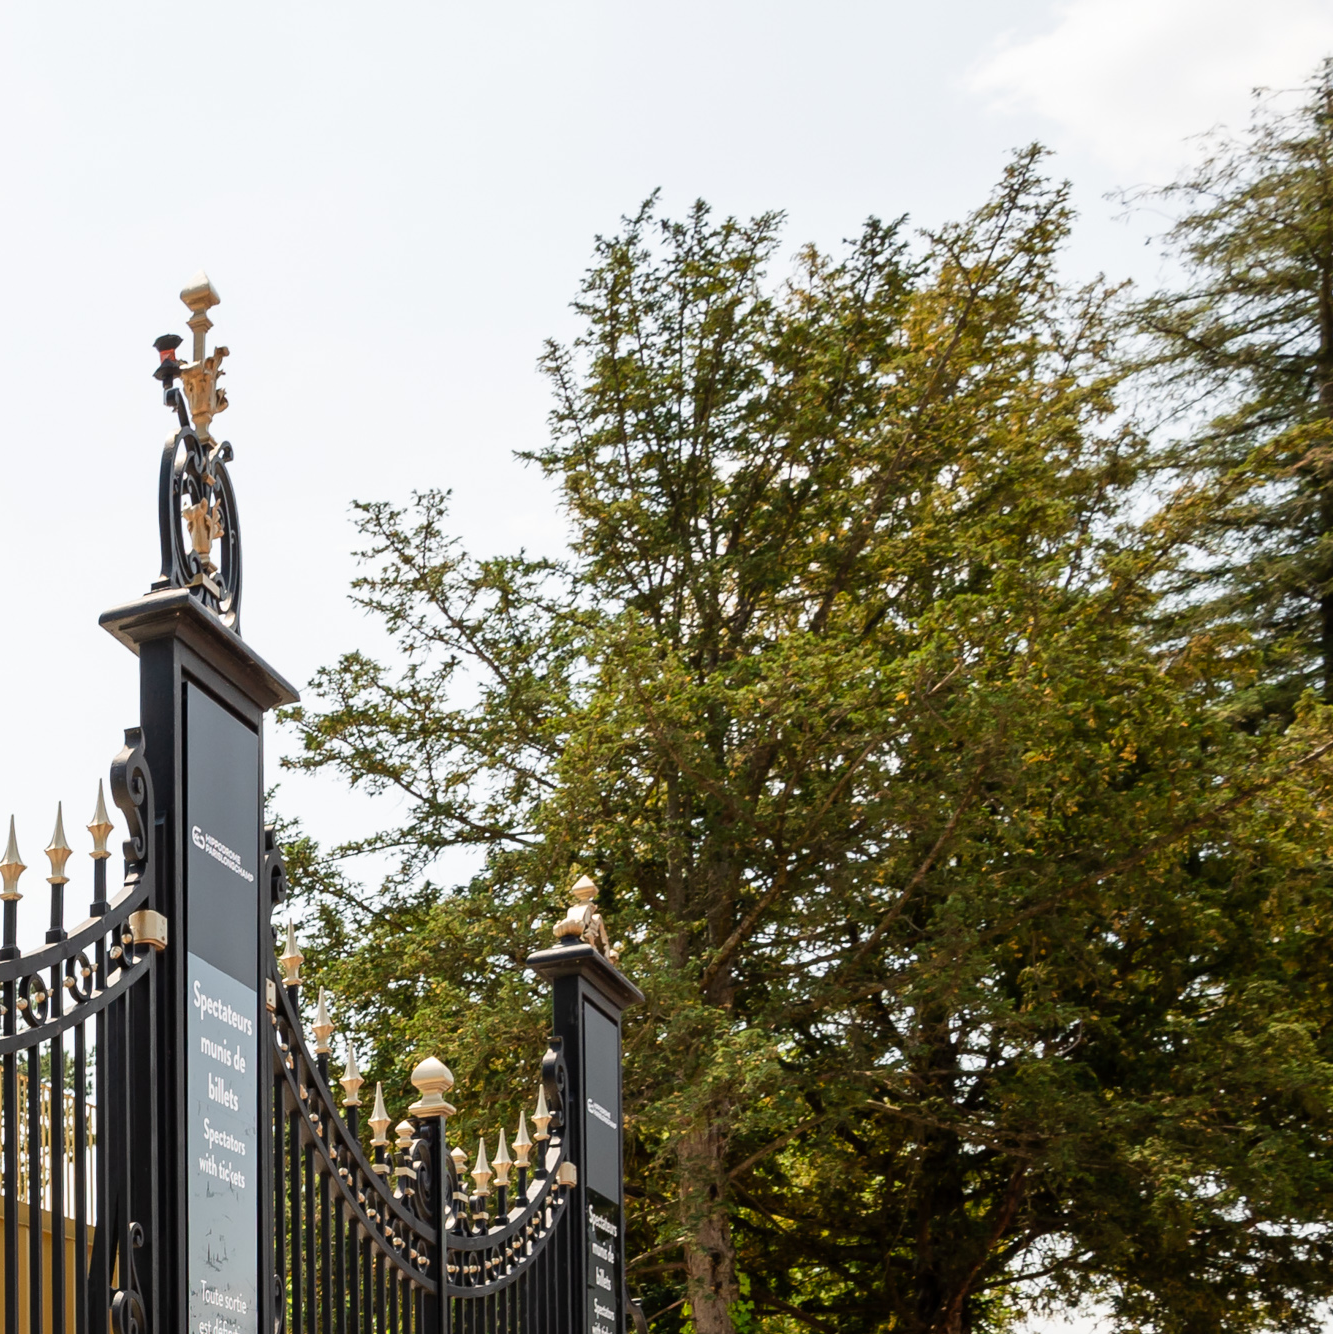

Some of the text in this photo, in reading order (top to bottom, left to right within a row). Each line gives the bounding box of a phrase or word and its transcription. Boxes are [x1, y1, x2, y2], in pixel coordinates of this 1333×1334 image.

[193, 980, 252, 1036] Spectateurs
[201, 1037, 246, 1073] munis de
[208, 1072, 239, 1111] billets
[203, 1118, 246, 1156] Spectators
[199, 1153, 246, 1188] with tickets
[589, 1205, 618, 1237] Spectateurs
[201, 1279, 247, 1314] Toute sortie
